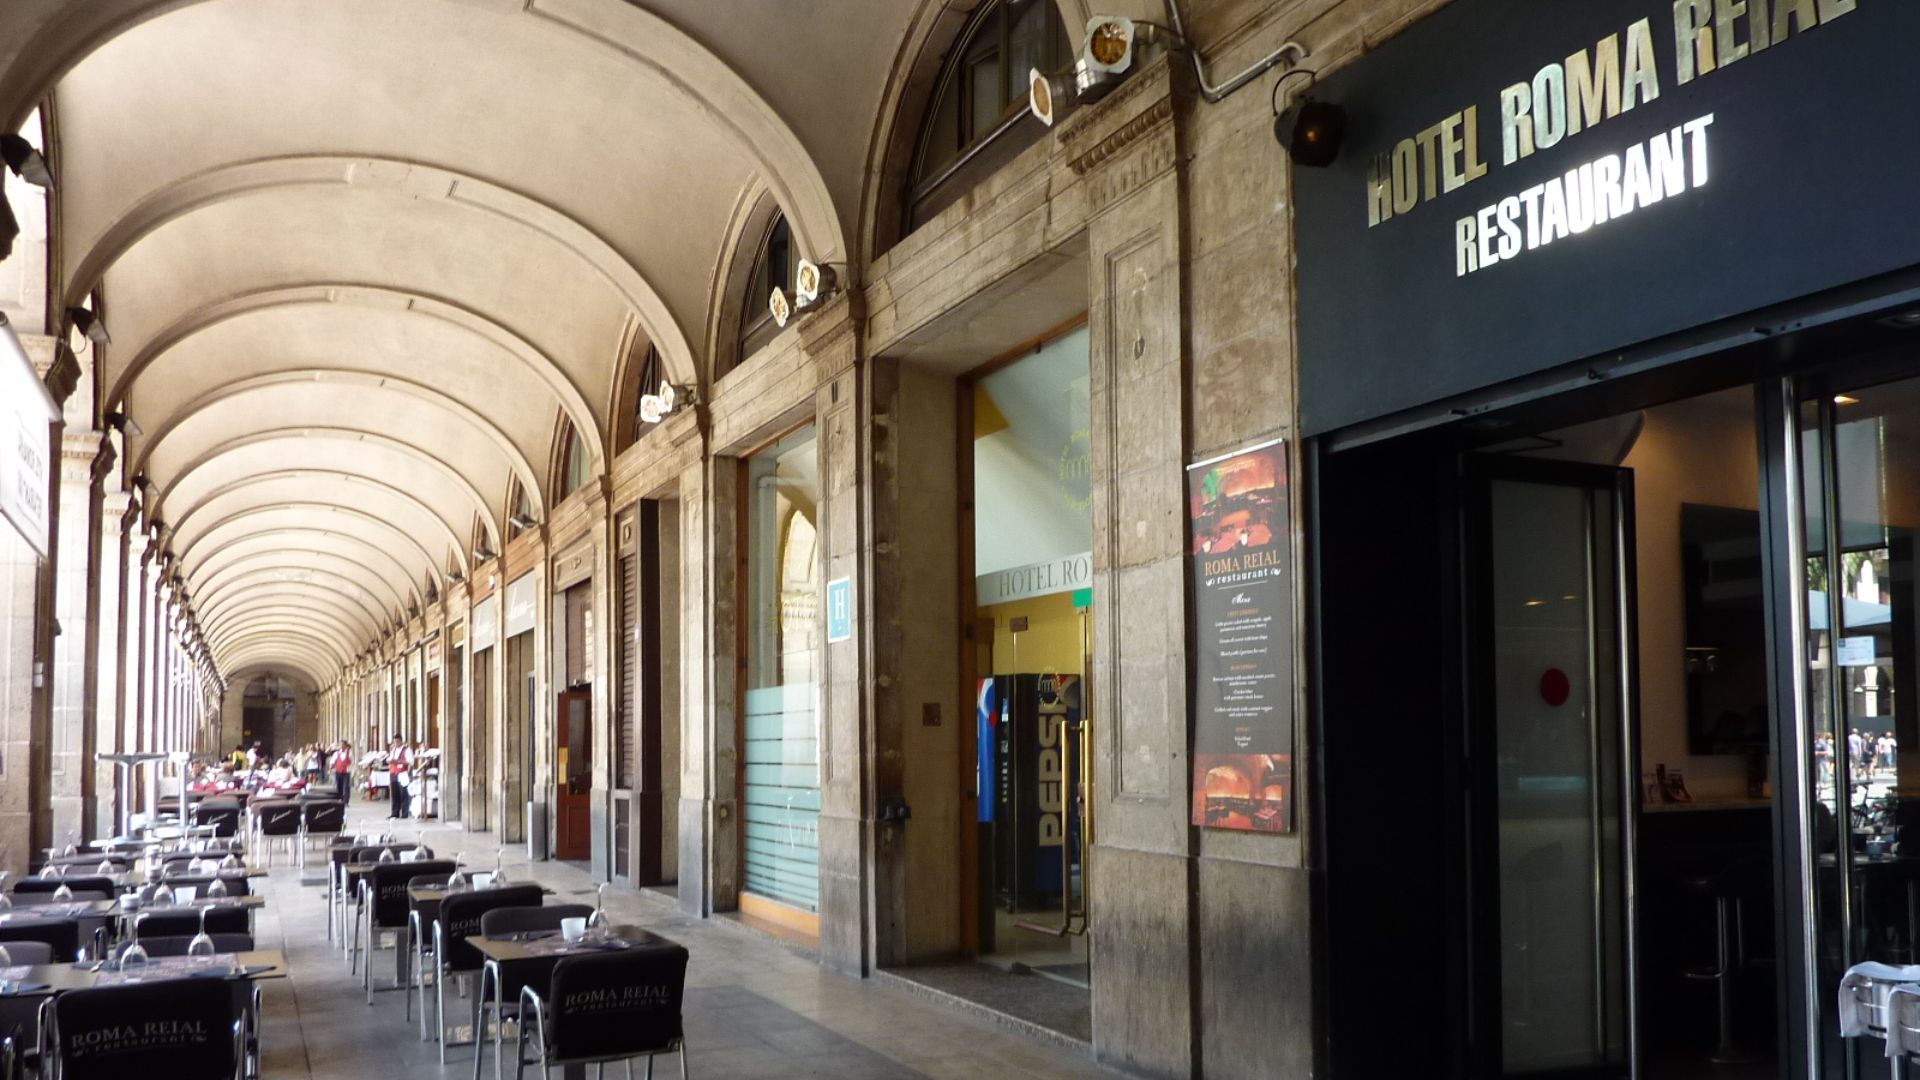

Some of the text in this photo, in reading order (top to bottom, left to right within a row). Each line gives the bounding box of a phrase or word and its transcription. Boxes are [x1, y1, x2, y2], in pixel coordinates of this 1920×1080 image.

[1367, 0, 1858, 228] HOTEL ROMA REI
[1456, 113, 1715, 277] RESTAURANT
[999, 555, 1092, 597] HOTEL RO
[1205, 549, 1281, 577] ROMA REIAL
[1217, 567, 1268, 585] restaurant
[1038, 703, 1068, 847] PEPSI
[565, 985, 672, 1008] ROMA REIAL
[71, 1020, 208, 1049] ROMA REIAL
